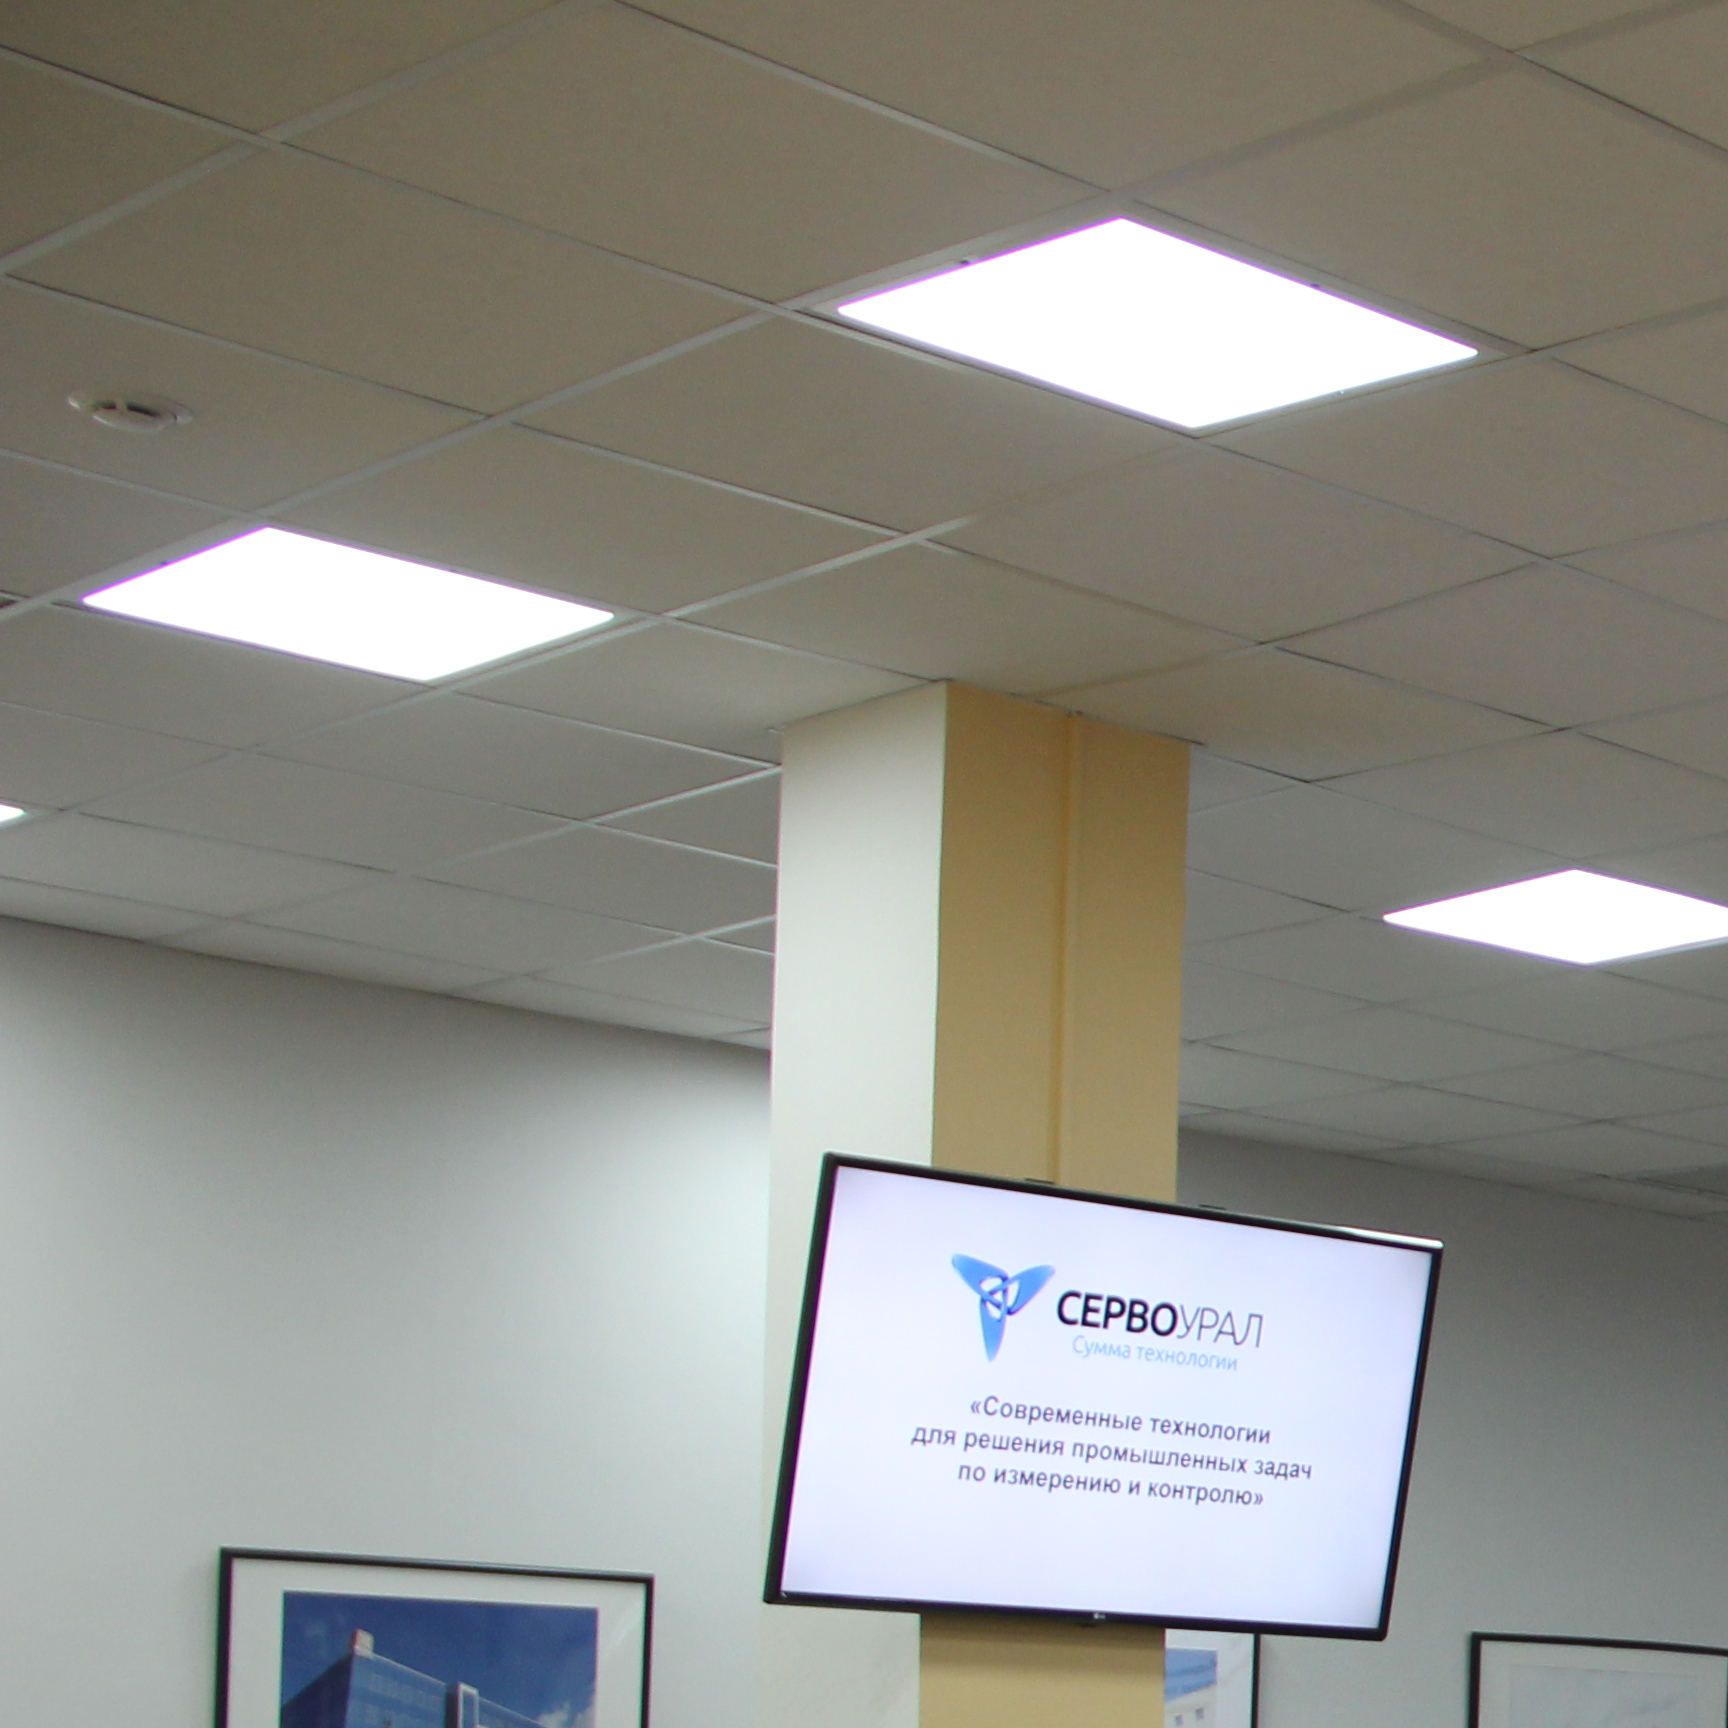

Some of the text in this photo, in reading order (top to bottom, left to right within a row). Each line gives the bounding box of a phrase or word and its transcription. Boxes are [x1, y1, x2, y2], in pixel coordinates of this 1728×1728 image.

[1057, 1290, 1264, 1348] СЕРВОУРАЛ
[1072, 1336, 1238, 1371] Сумма технологии
[970, 1395, 1271, 1444] «Современные технологии
[911, 1426, 1312, 1481] для решения промышленных задач
[958, 1464, 1264, 1506] по измерению и контролю»
